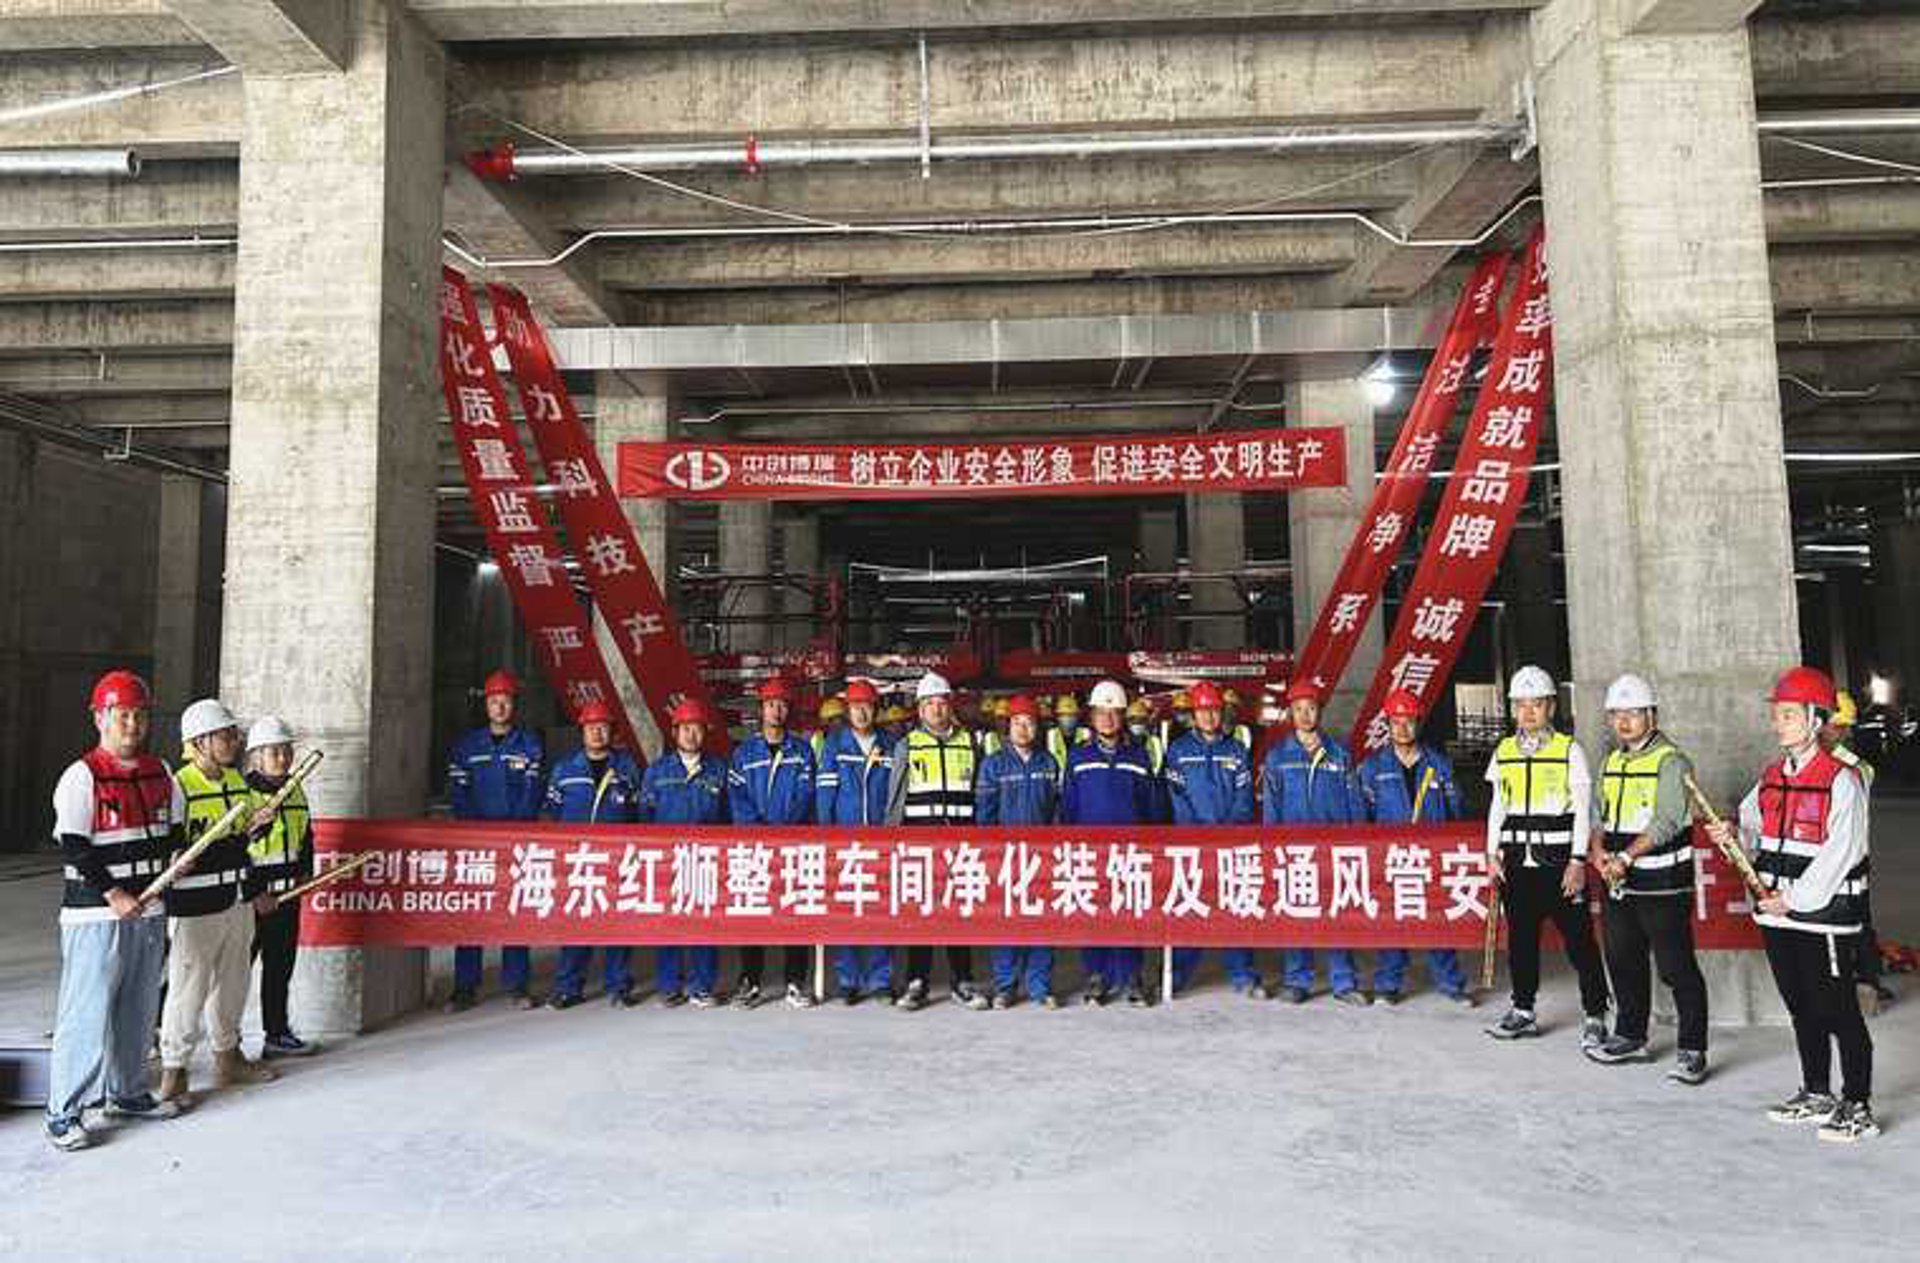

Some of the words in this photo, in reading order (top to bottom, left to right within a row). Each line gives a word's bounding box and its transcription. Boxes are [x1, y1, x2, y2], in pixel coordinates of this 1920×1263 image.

[850, 446, 1075, 486] 树立企业安全形象
[1091, 438, 1323, 483] 促进安全文明生产
[1312, 275, 1495, 688] 专注洁净系
[312, 848, 497, 885] 中创博瑞
[311, 891, 400, 913] CHINA
[402, 891, 497, 913] BRIGHT
